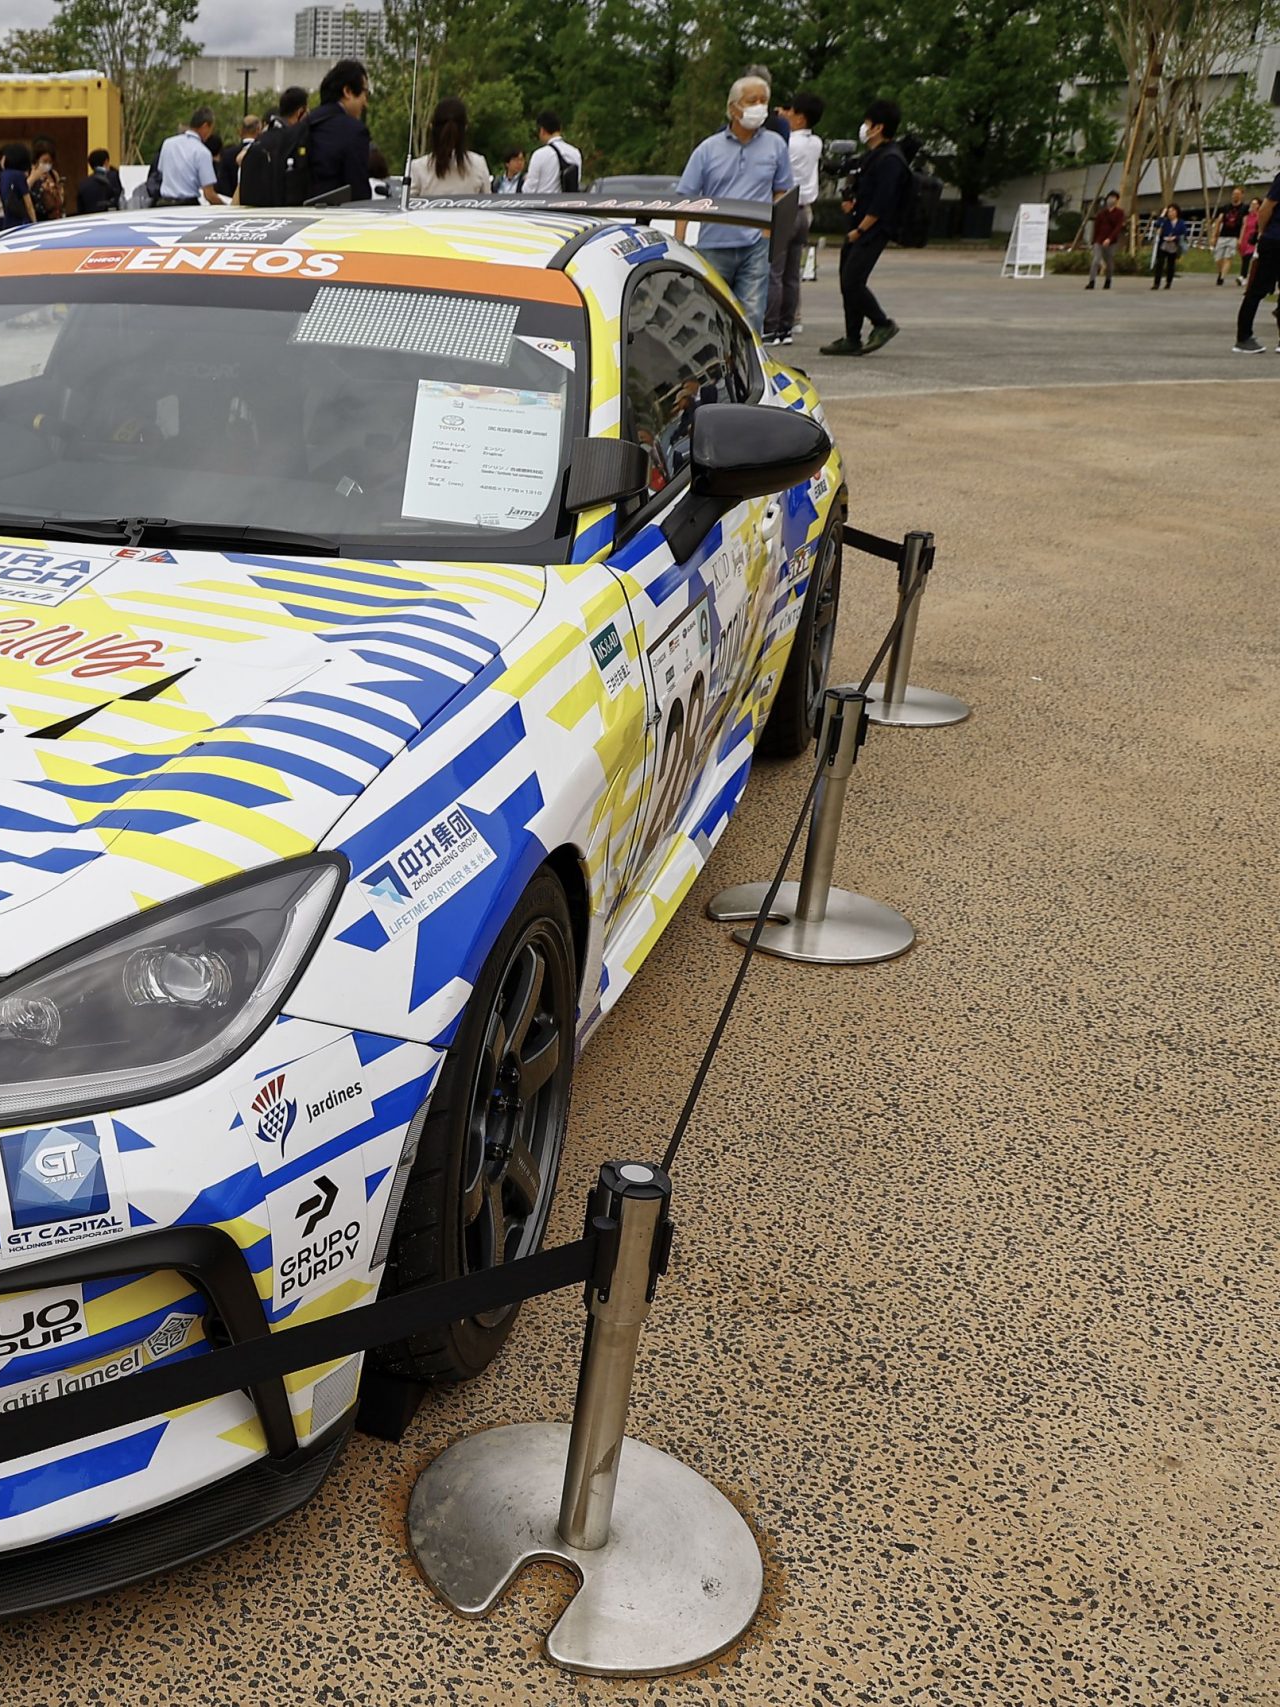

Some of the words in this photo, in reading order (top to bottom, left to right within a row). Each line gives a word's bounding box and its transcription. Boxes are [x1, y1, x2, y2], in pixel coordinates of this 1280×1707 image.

[87, 255, 121, 265] ENEOS
[124, 247, 345, 278] ENEOS
[439, 424, 466, 432] TOYOTA
[505, 506, 541, 518] jama
[115, 548, 141, 559] E
[700, 609, 709, 646] Q
[594, 631, 619, 661] MS&AD
[637, 669, 706, 864] 28
[398, 808, 473, 879] 中升集团
[411, 850, 459, 891] ZHONGSHENG
[457, 832, 479, 853] GROUP
[388, 900, 430, 935] LIFETIME
[427, 870, 466, 905] PARTNER
[305, 1081, 363, 1123] Jardines
[35, 1142, 81, 1177] GT
[43, 1172, 85, 1184] CAPITAL
[7, 1231, 32, 1246] GT
[38, 1216, 123, 1240] CAPITAL
[8, 1240, 53, 1254] HOLDINGS
[54, 1227, 124, 1245] INCORPORATED
[280, 1221, 360, 1277] GRUPO
[280, 1240, 360, 1299] PURDY
